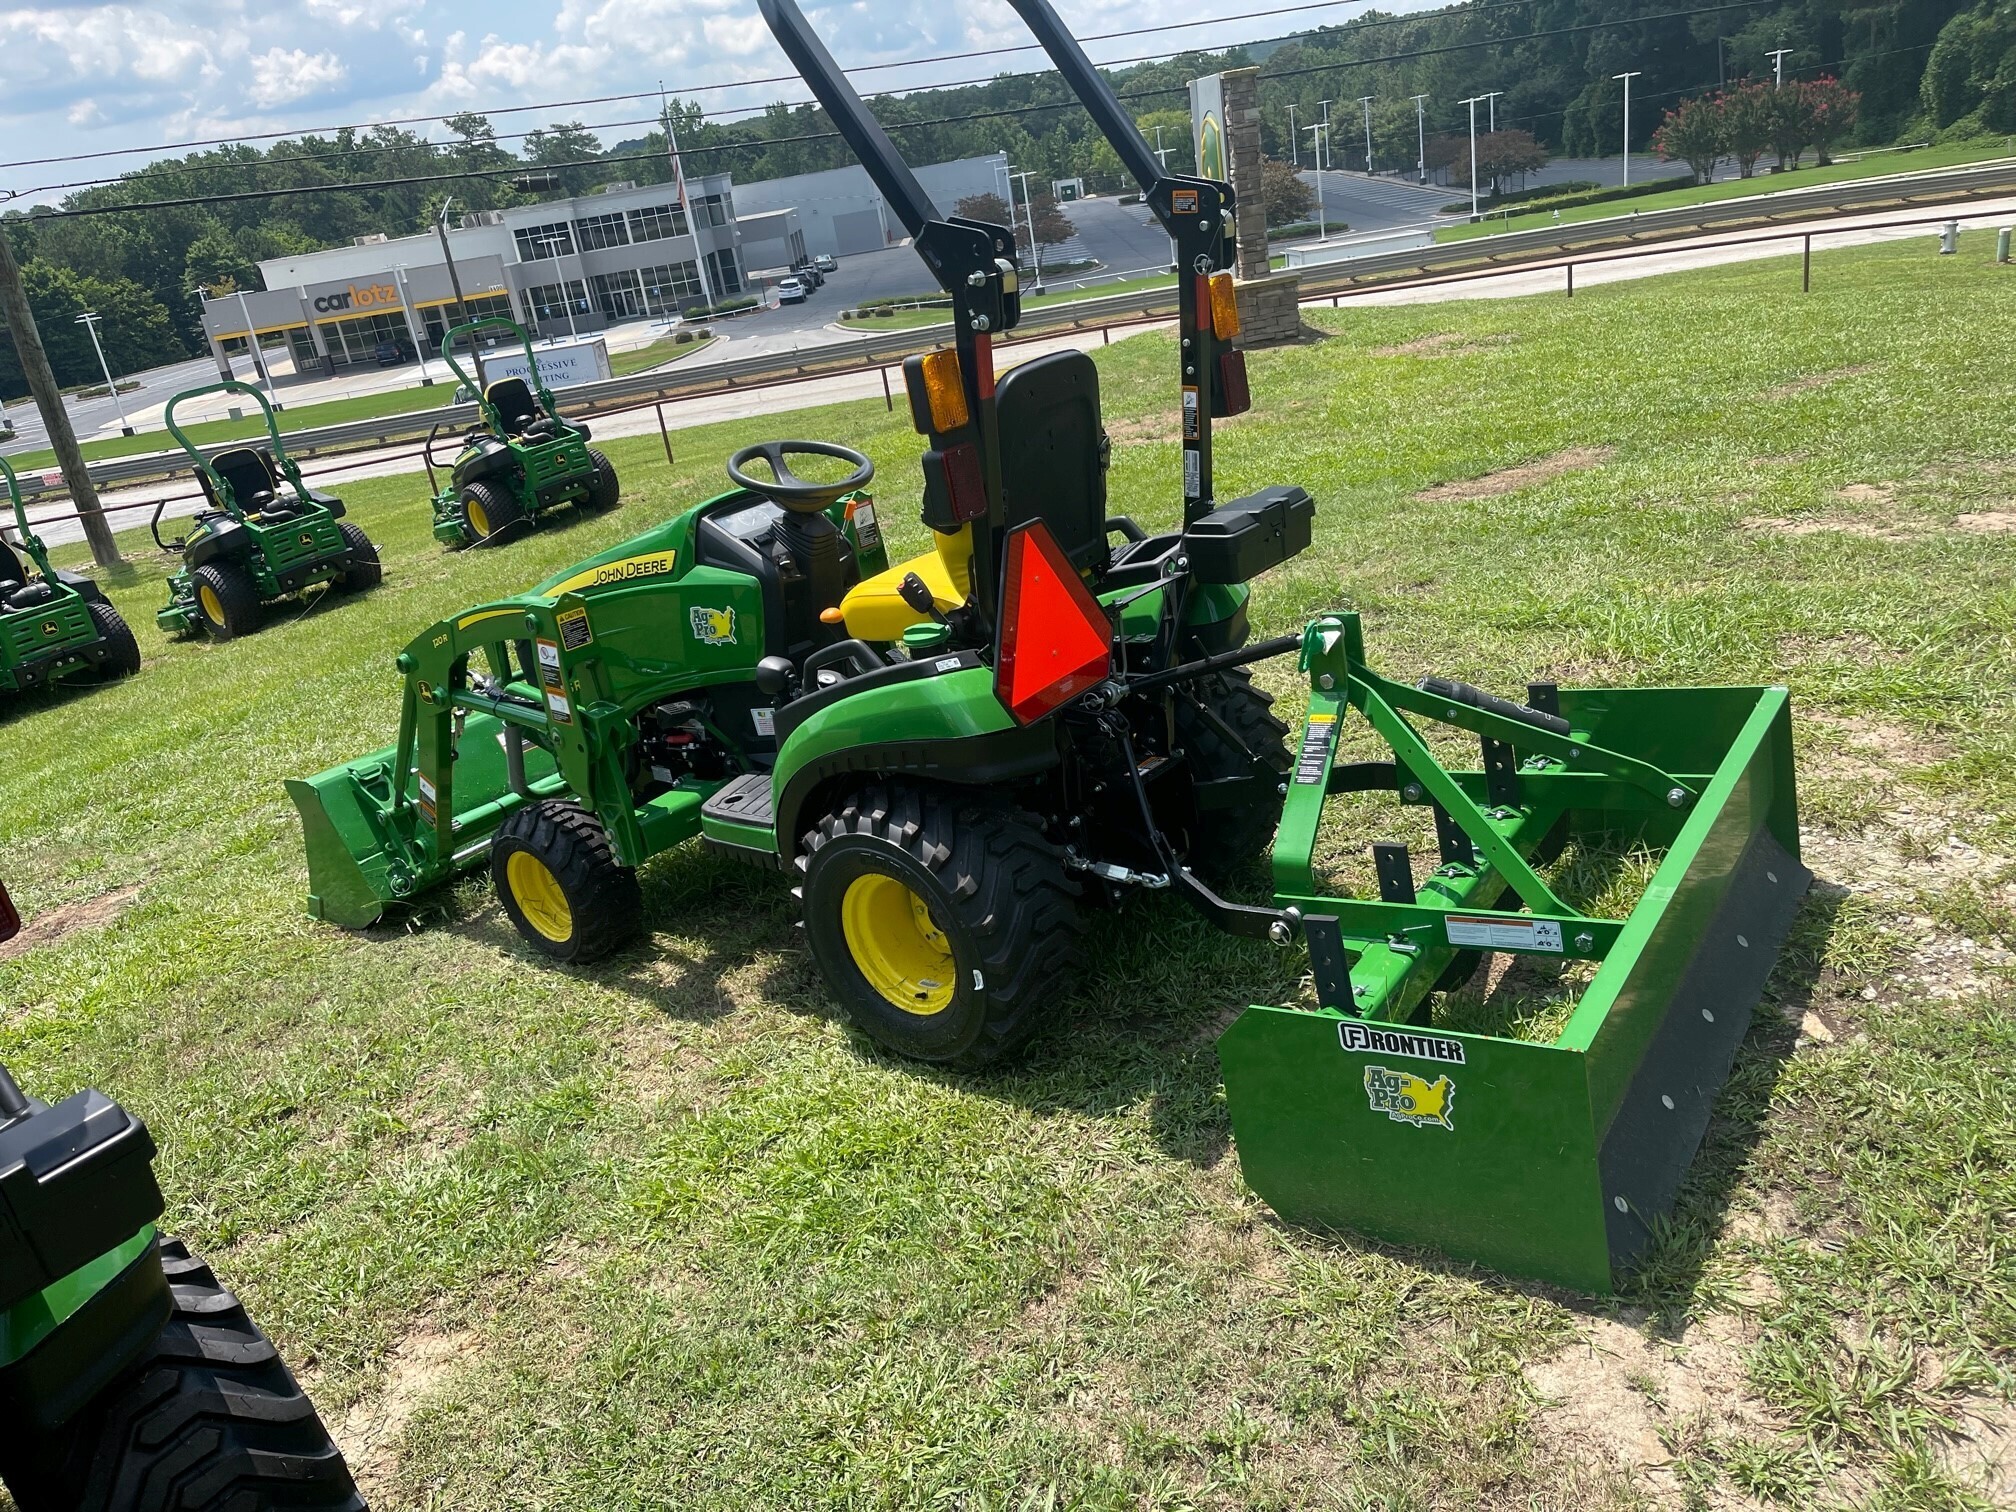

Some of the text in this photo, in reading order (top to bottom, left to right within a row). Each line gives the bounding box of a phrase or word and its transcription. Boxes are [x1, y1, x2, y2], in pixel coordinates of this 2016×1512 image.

[313, 283, 399, 313] carlotz
[593, 559, 669, 586] JOHN DEERE
[695, 622, 716, 636] Pro
[1368, 1069, 1411, 1093] Ag-
[1371, 1089, 1416, 1111] Pro
